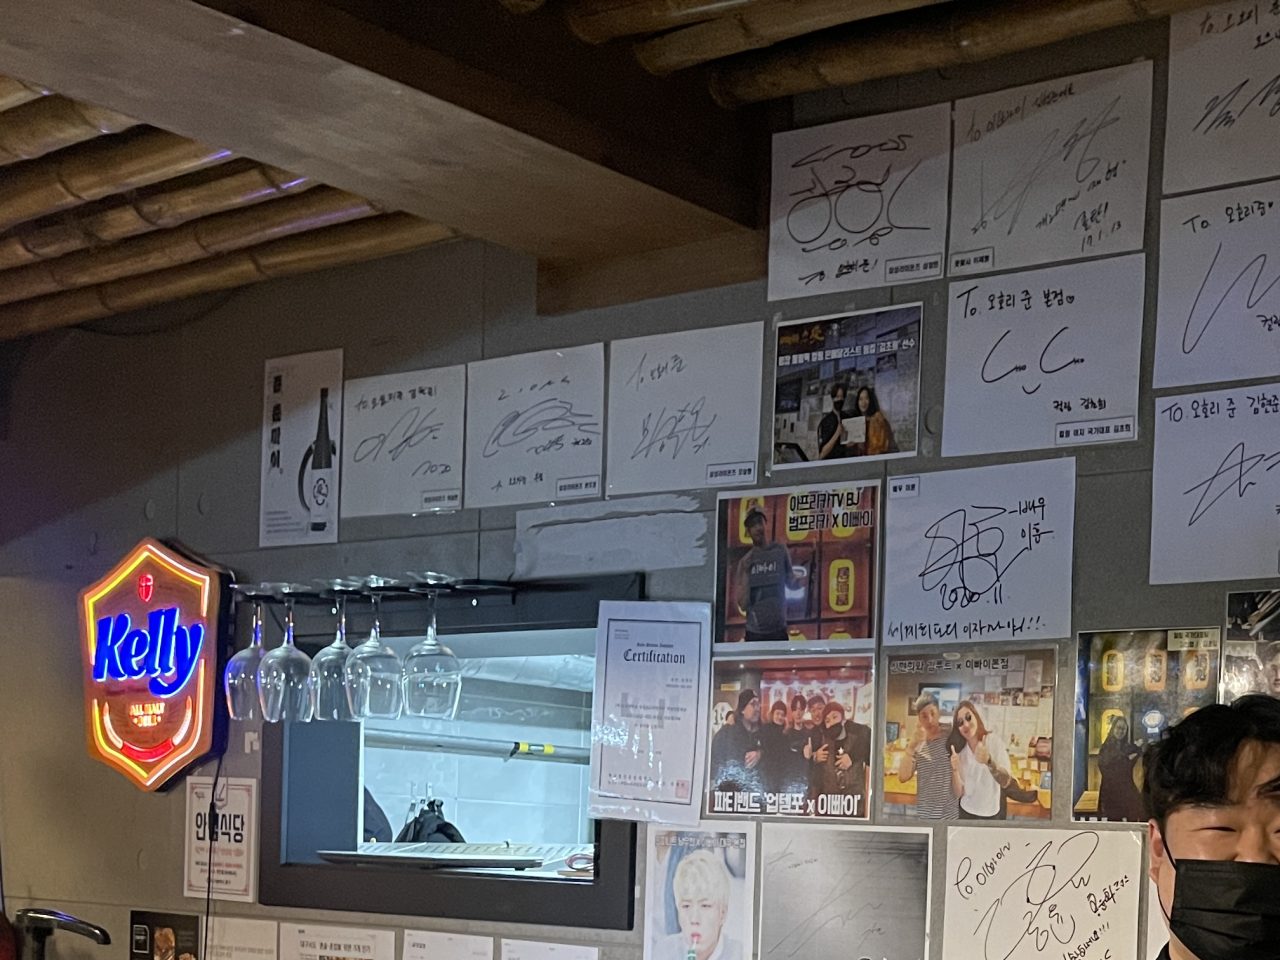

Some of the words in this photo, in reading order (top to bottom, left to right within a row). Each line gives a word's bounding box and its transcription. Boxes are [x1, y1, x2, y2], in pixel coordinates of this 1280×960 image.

[846, 489, 863, 507] BJ
[841, 509, 874, 529] 이빠이
[93, 607, 206, 698] Kelly
[623, 649, 686, 665] Certification
